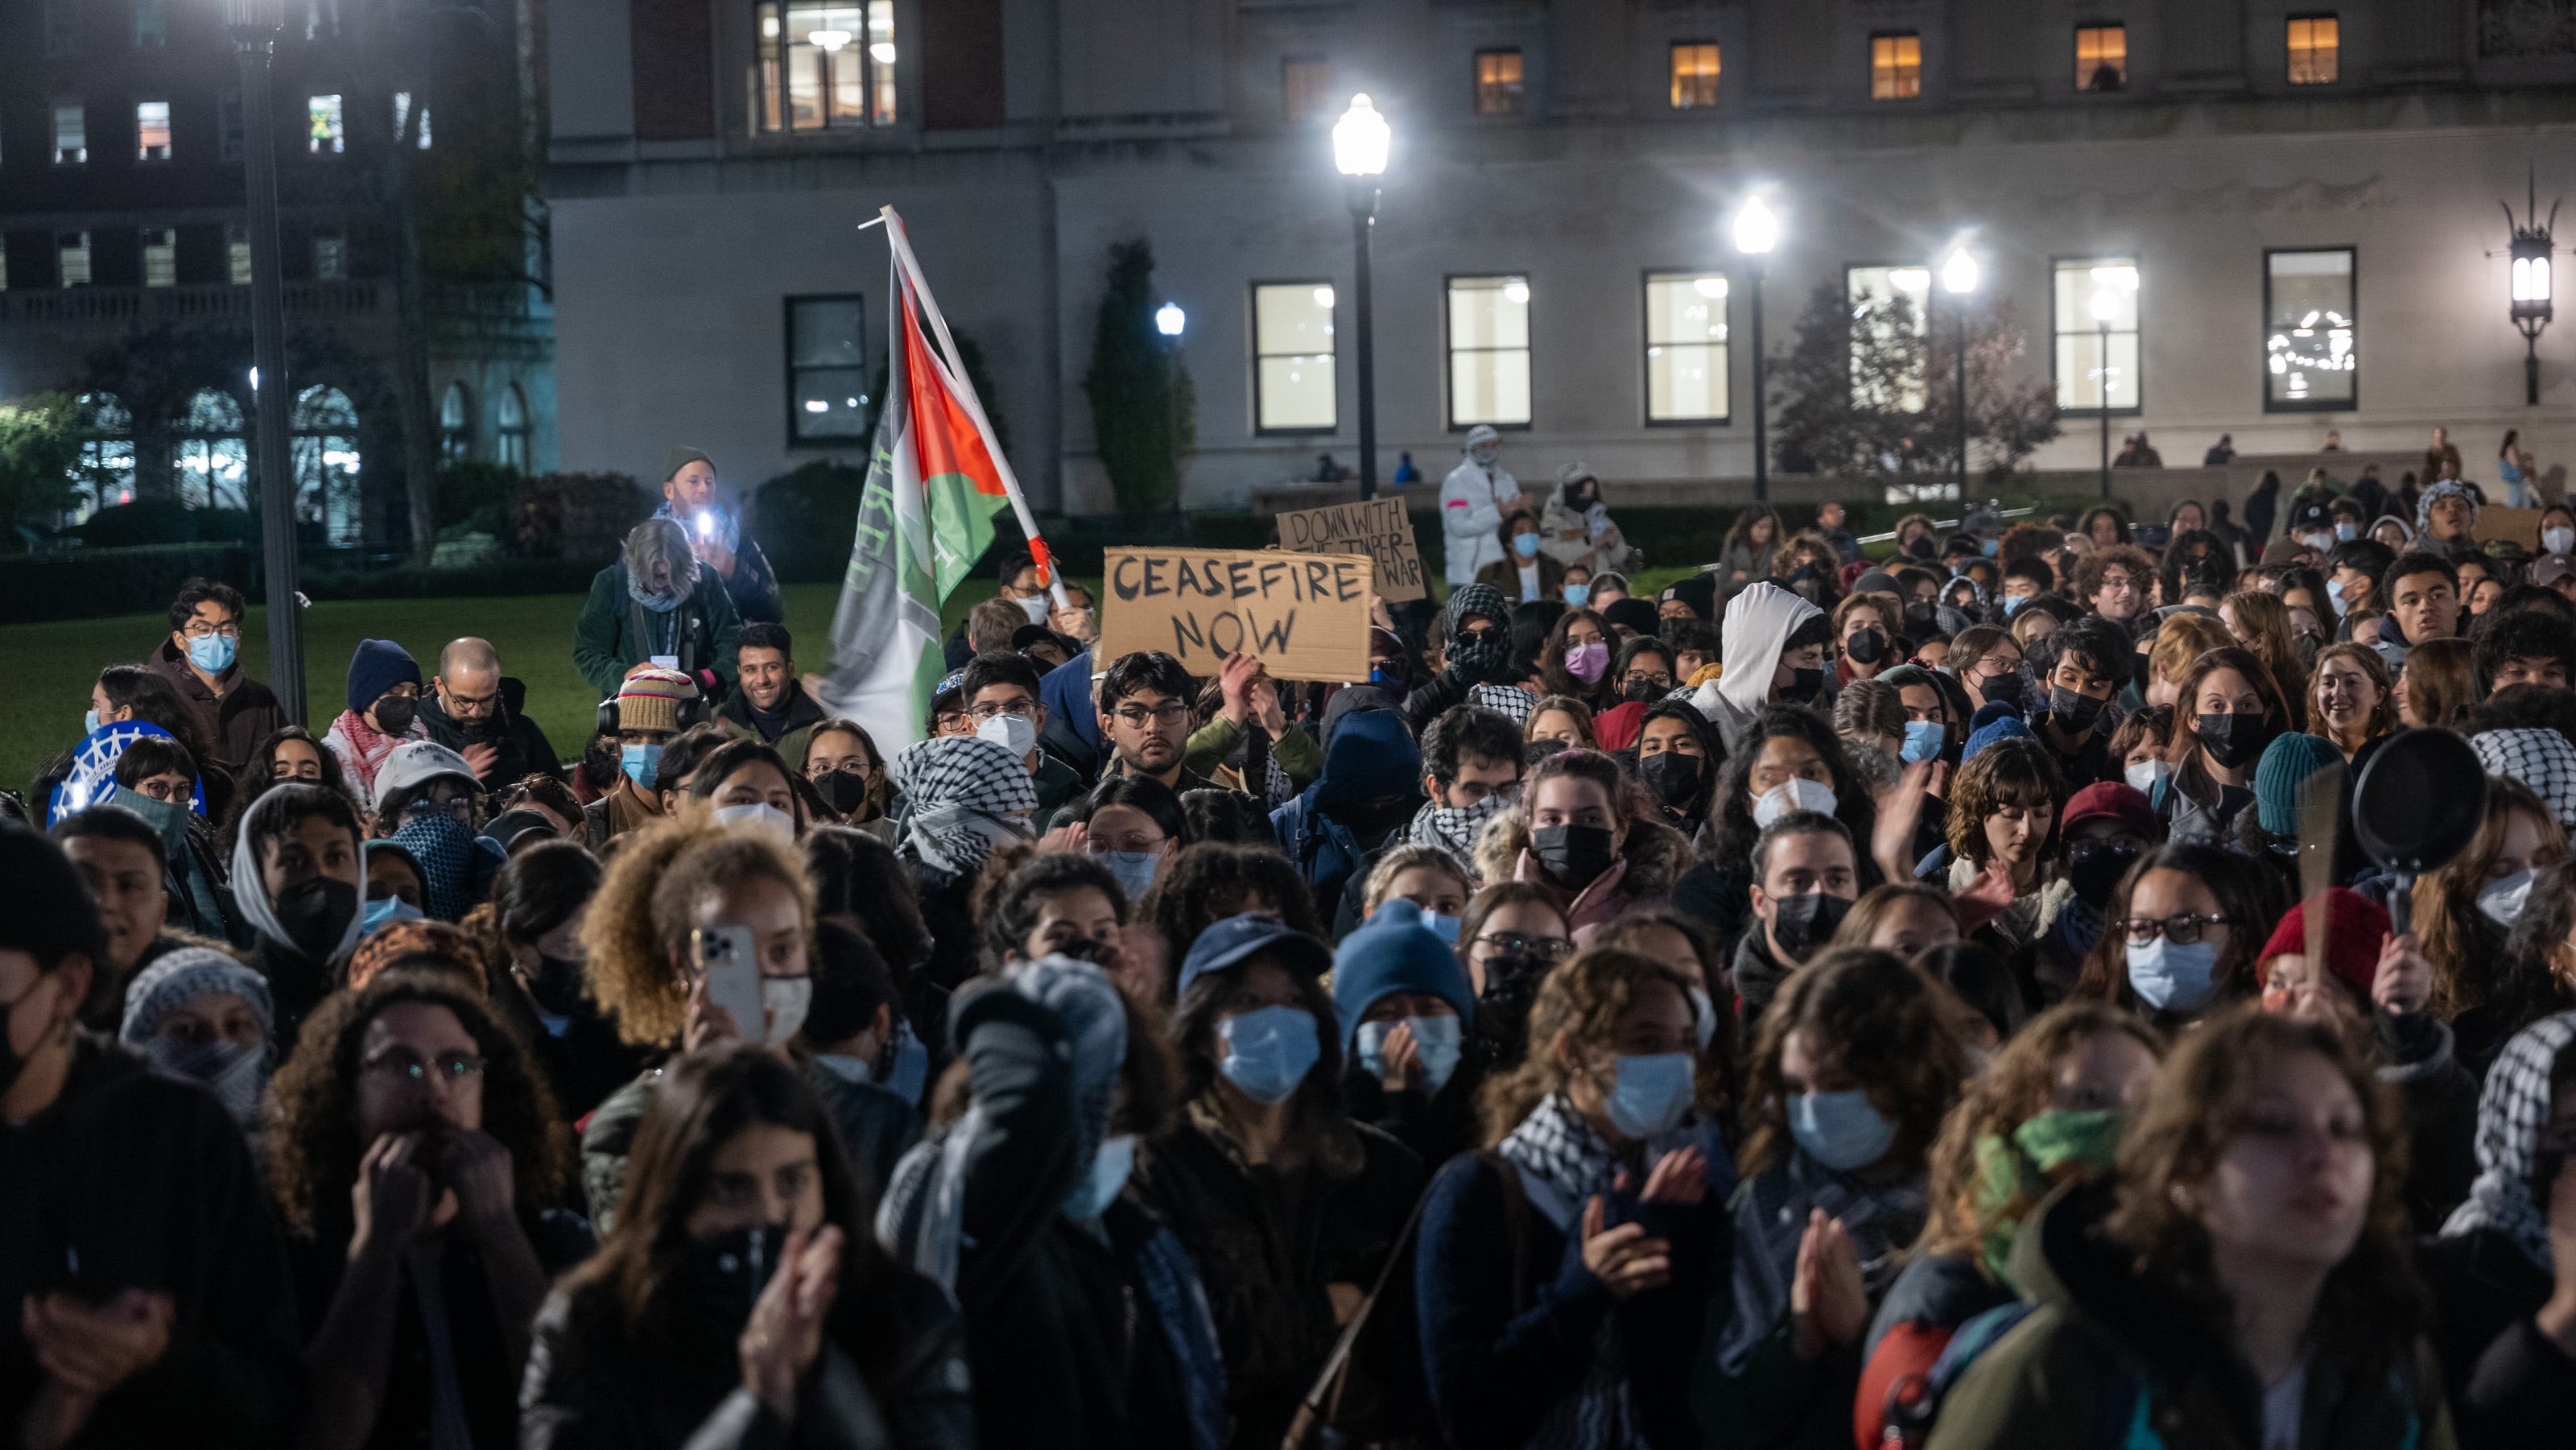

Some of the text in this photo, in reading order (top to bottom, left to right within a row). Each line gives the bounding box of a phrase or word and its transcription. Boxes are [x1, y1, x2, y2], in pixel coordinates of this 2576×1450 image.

[1290, 499, 1403, 544] DOWN WITH
[1113, 556, 1362, 602] CEASEFIRE
[1383, 559, 1421, 587] WAR
[1171, 608, 1295, 660] NOW
